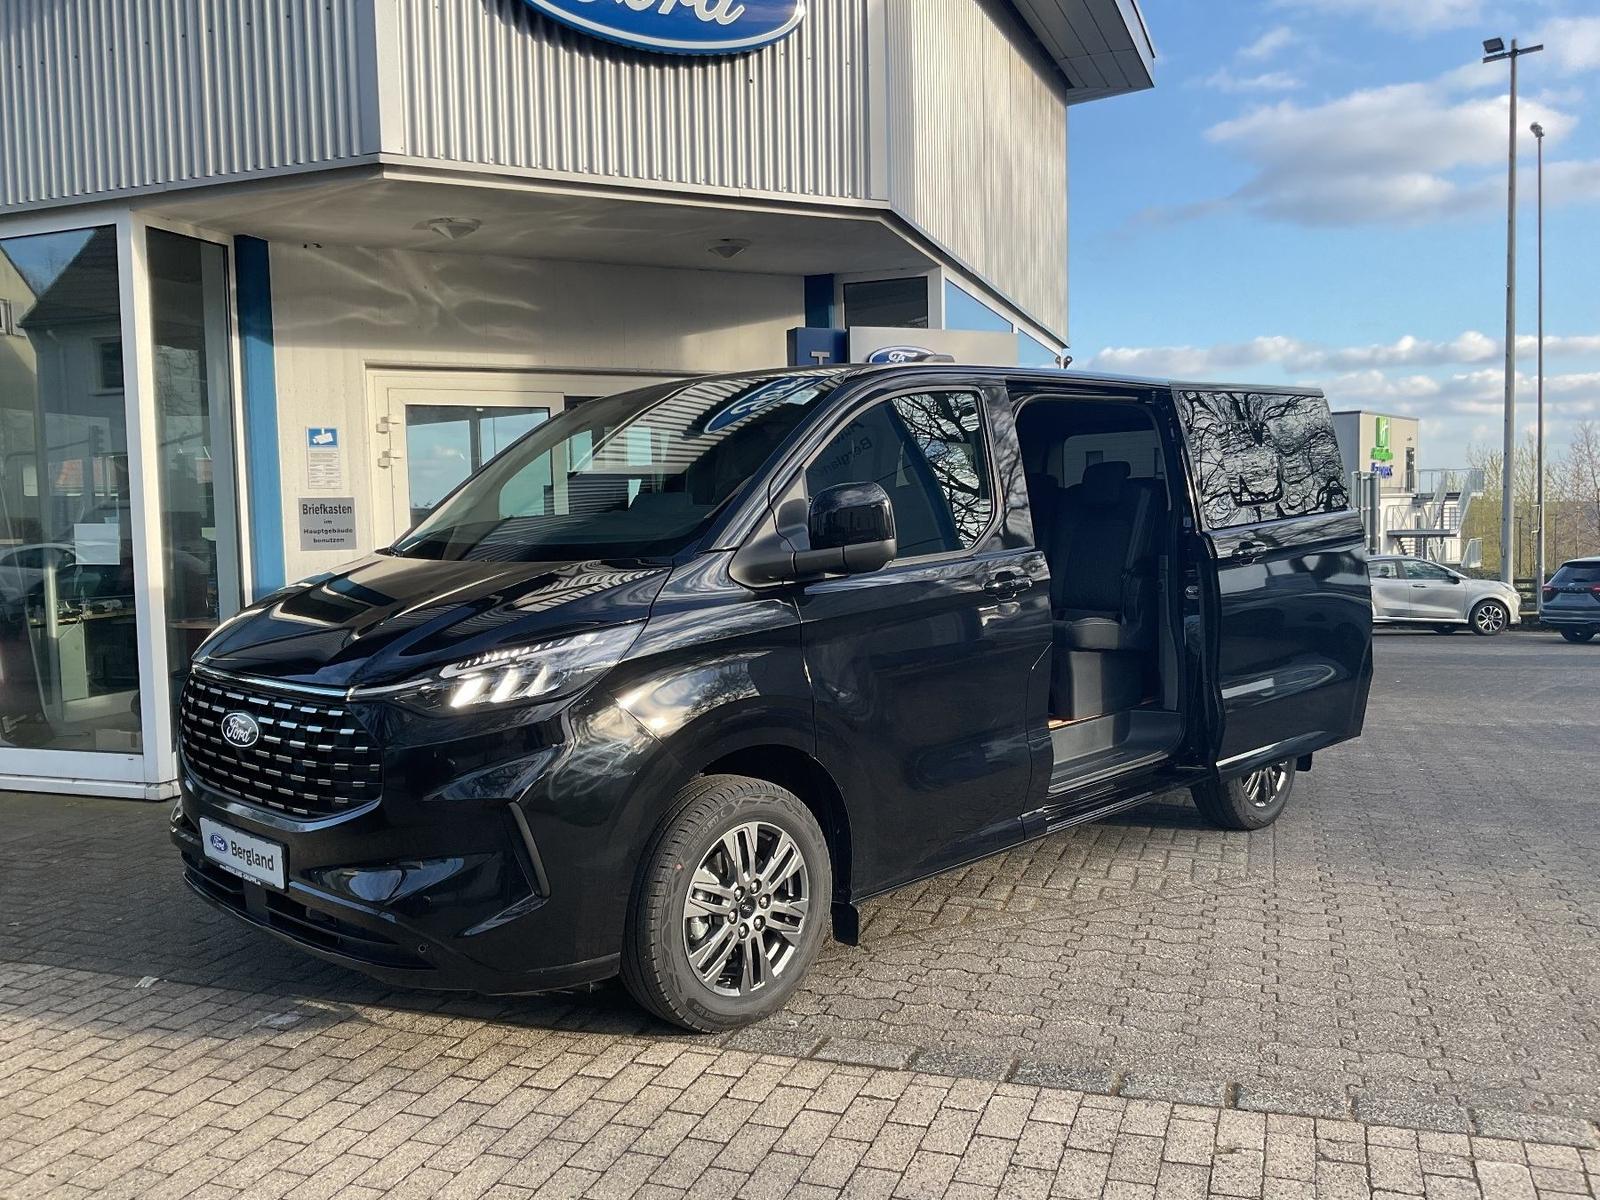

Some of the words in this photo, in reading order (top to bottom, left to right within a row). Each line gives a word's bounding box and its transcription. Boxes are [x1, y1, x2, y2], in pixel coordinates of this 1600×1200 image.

[302, 503, 352, 515] Briefkasten
[226, 716, 252, 743] Ford
[230, 839, 275, 872] Bergland
